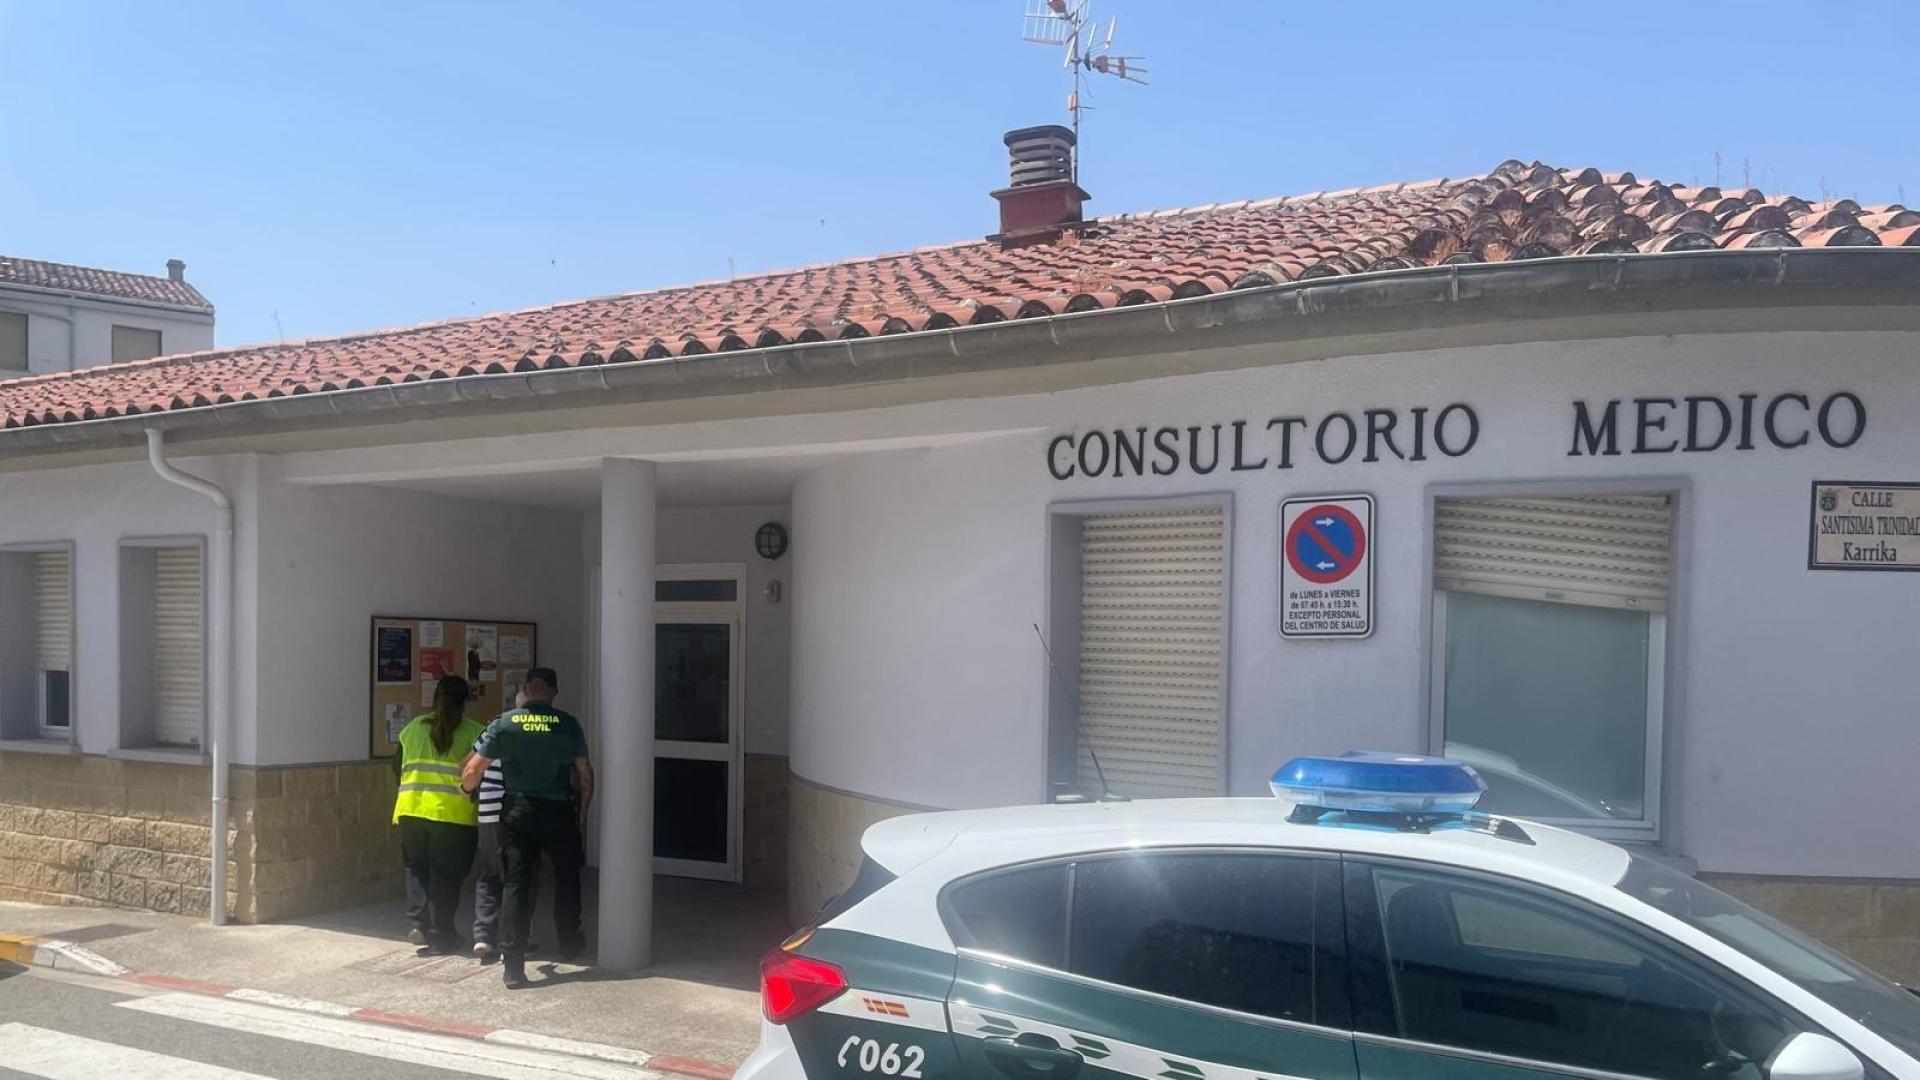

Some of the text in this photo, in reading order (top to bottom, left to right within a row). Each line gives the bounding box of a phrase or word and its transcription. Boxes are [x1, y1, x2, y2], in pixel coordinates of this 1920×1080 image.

[1047, 391, 1867, 480] CONSULTORIO MEDICO
[1852, 491, 1894, 508] CALLE
[1842, 540, 1897, 562] Karrika
[1290, 591, 1298, 599] de
[1299, 589, 1323, 599] LUNES
[1330, 589, 1360, 598] VIERNES
[1291, 601, 1299, 609] de
[1289, 610, 1361, 619] EXCEPTO PERSONAL
[1284, 620, 1365, 630] DEL CENTRO DE SALUD
[511, 714, 560, 724] GUARDIA
[522, 723, 552, 732] CIVIL
[859, 1039, 925, 1079] 062
